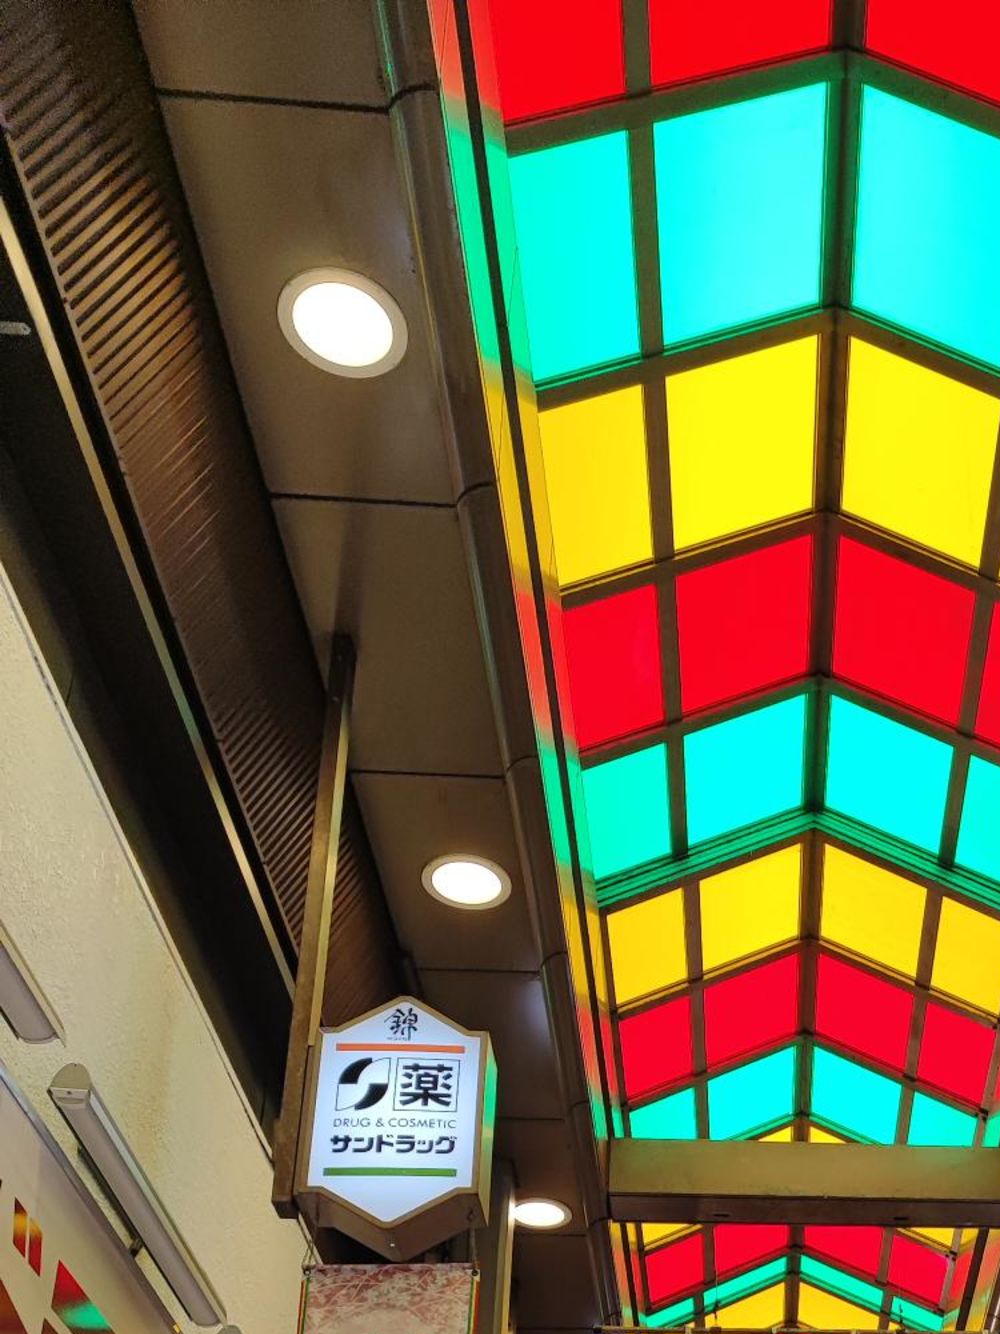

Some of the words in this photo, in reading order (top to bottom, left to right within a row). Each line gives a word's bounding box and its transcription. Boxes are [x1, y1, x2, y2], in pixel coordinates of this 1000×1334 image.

[384, 1007, 418, 1041] 錦
[399, 1063, 453, 1106] 薬
[333, 1117, 371, 1127] DRUG
[376, 1118, 385, 1127] &
[388, 1117, 457, 1129] COSMETIC
[330, 1134, 457, 1154] サンドラッグ
